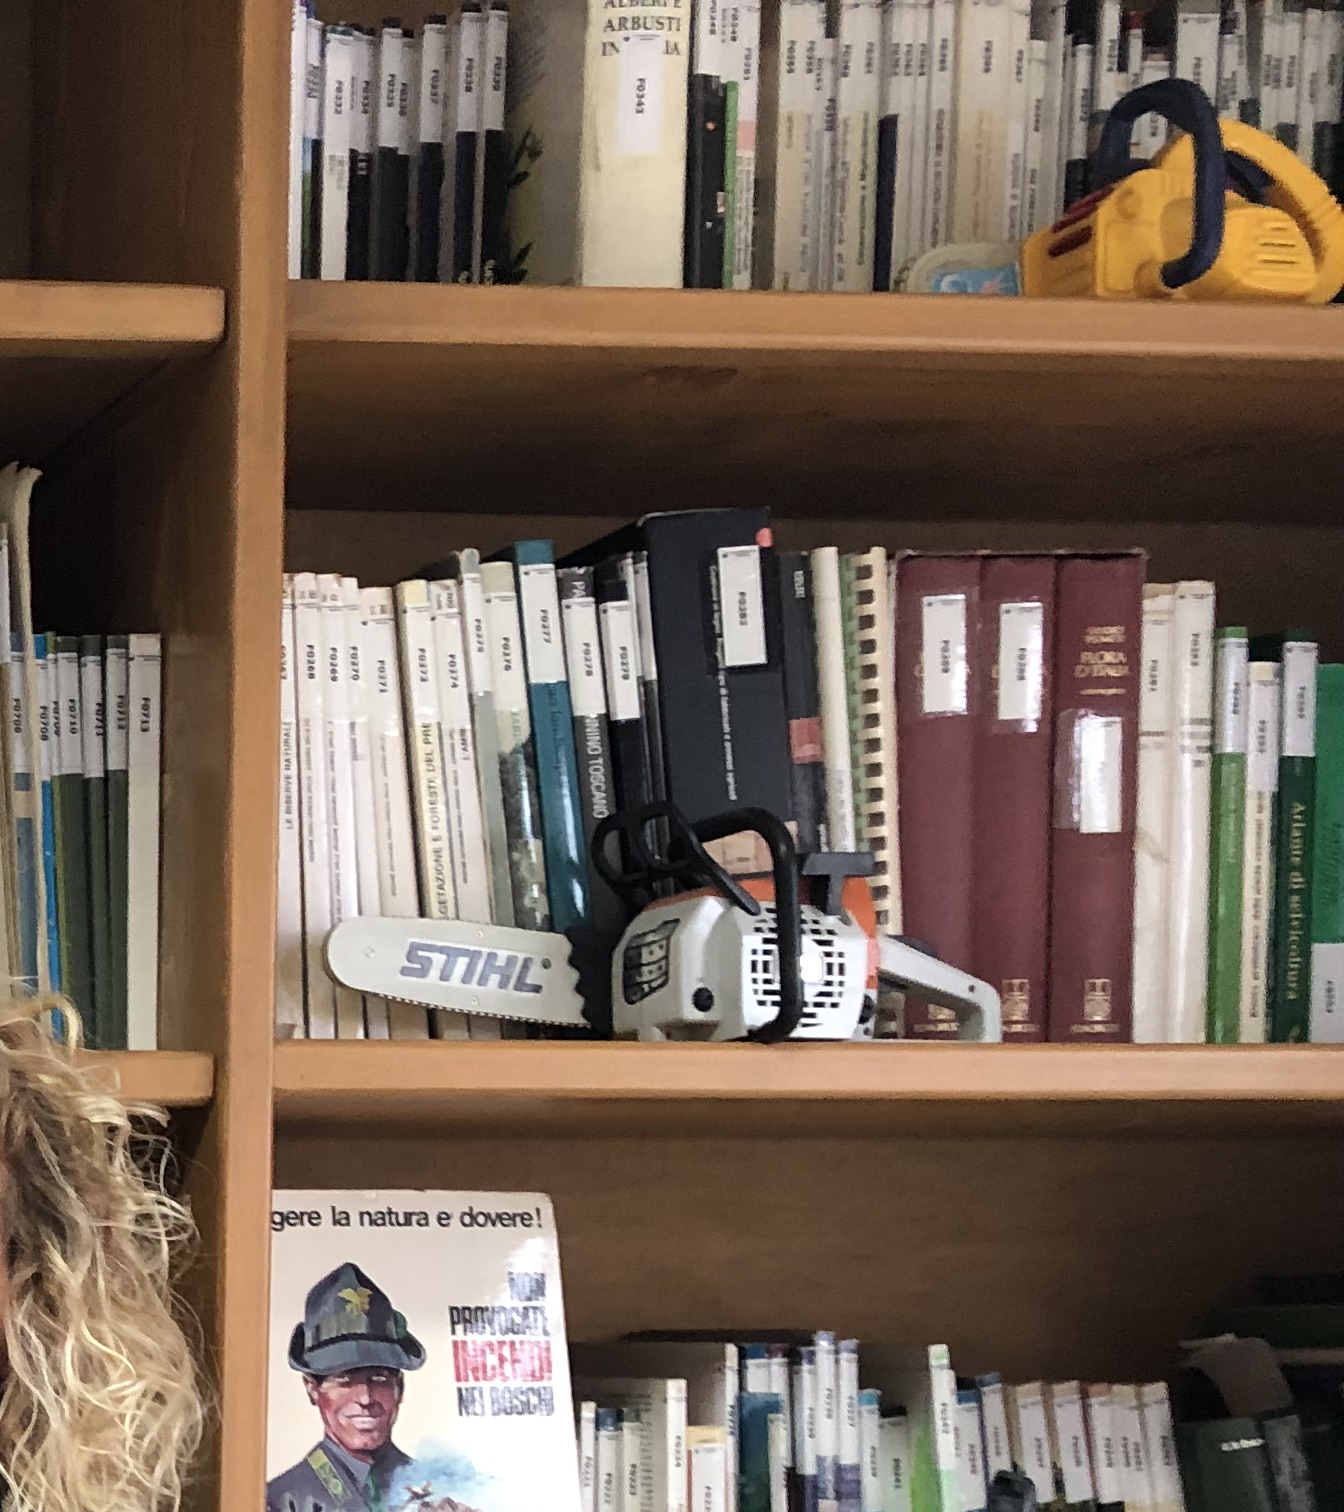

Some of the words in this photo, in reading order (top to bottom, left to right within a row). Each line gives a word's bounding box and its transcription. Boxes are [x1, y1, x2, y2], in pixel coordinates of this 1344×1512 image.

[603, 16, 682, 32] ARBUSTI
[425, 780, 441, 832] FORESTE
[587, 756, 610, 819] TOSCANO
[1289, 801, 1306, 867] Atlante
[1289, 871, 1306, 890] di
[400, 940, 543, 994] STIHL
[331, 1205, 351, 1228] la
[358, 1207, 430, 1228] natura
[460, 1205, 544, 1228] dovere!
[451, 1339, 553, 1382] INCENDI
[456, 1386, 485, 1417] NEI
[491, 1386, 556, 1417] BOSCHI
